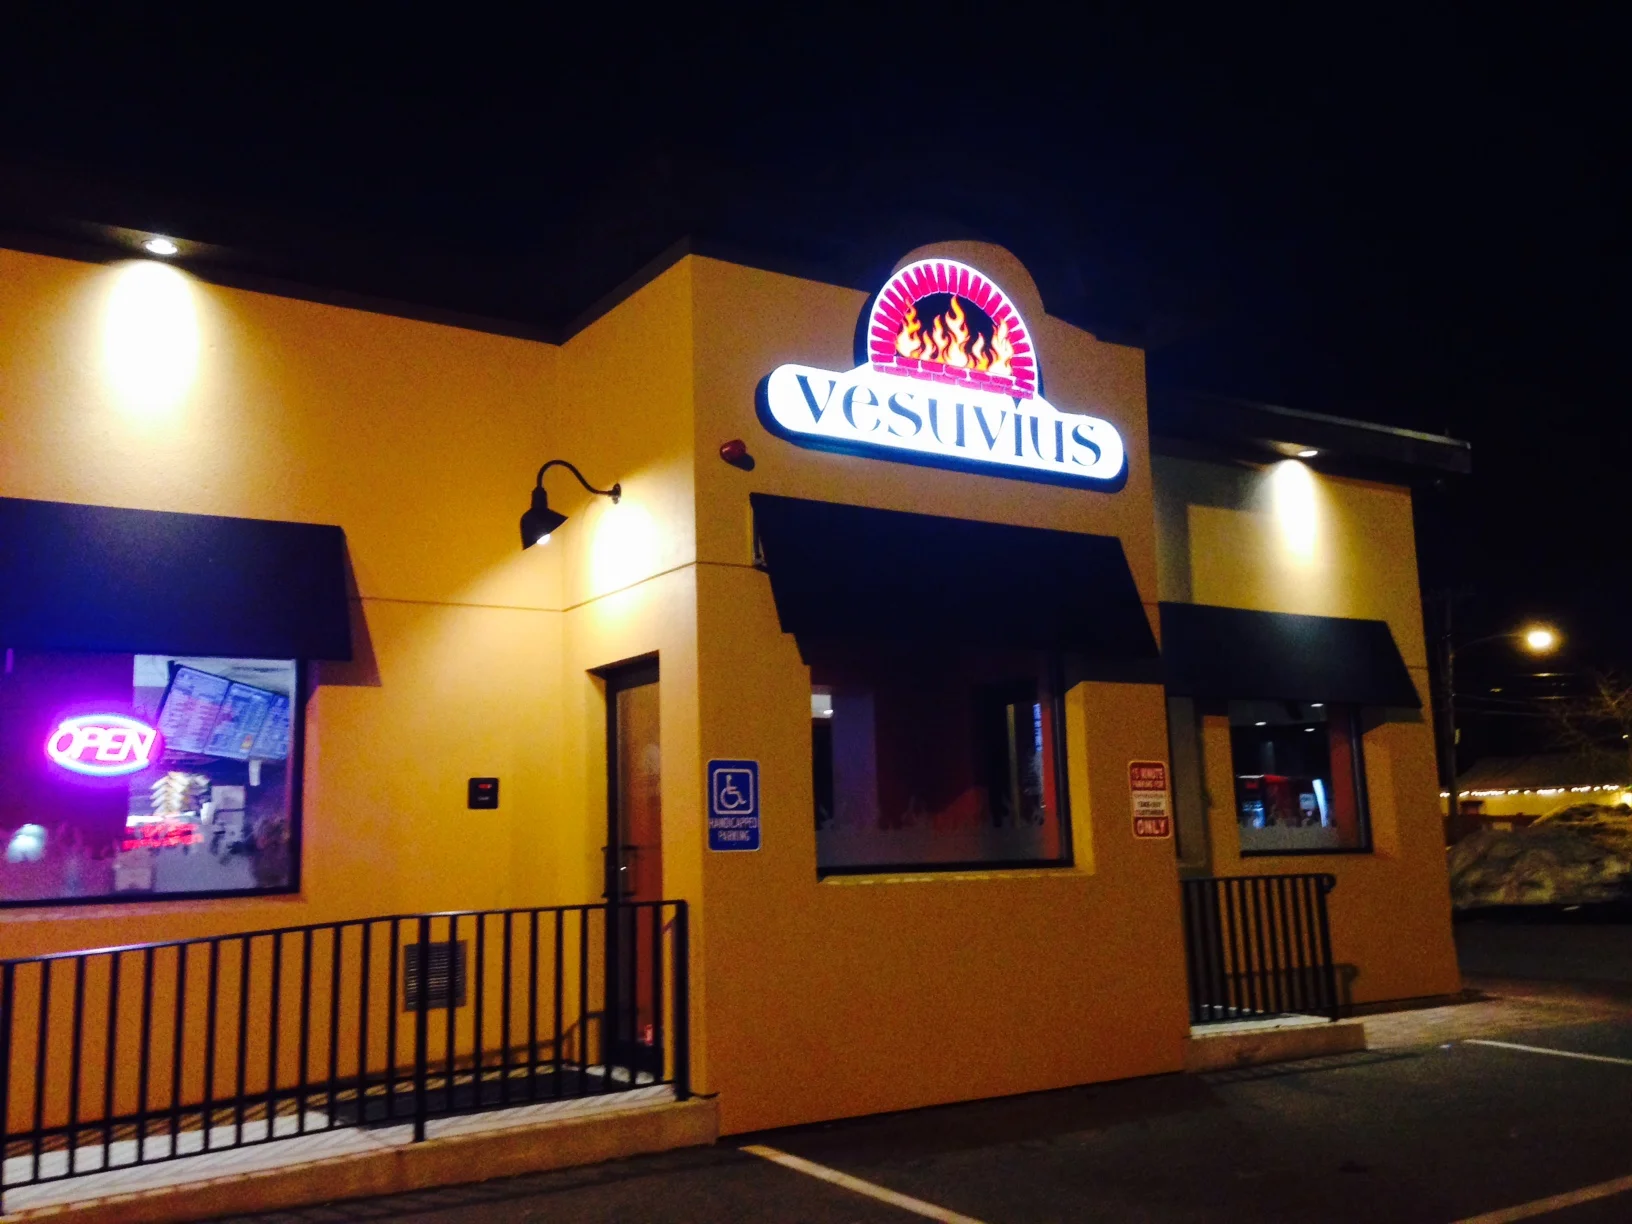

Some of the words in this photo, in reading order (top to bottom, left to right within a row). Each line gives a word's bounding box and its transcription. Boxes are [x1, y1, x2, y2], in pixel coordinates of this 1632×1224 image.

[47, 725, 157, 763] OPEN
[708, 817, 757, 828] HANDICAPPED
[1137, 819, 1165, 835] ONLY
[718, 830, 750, 841] PARKING
